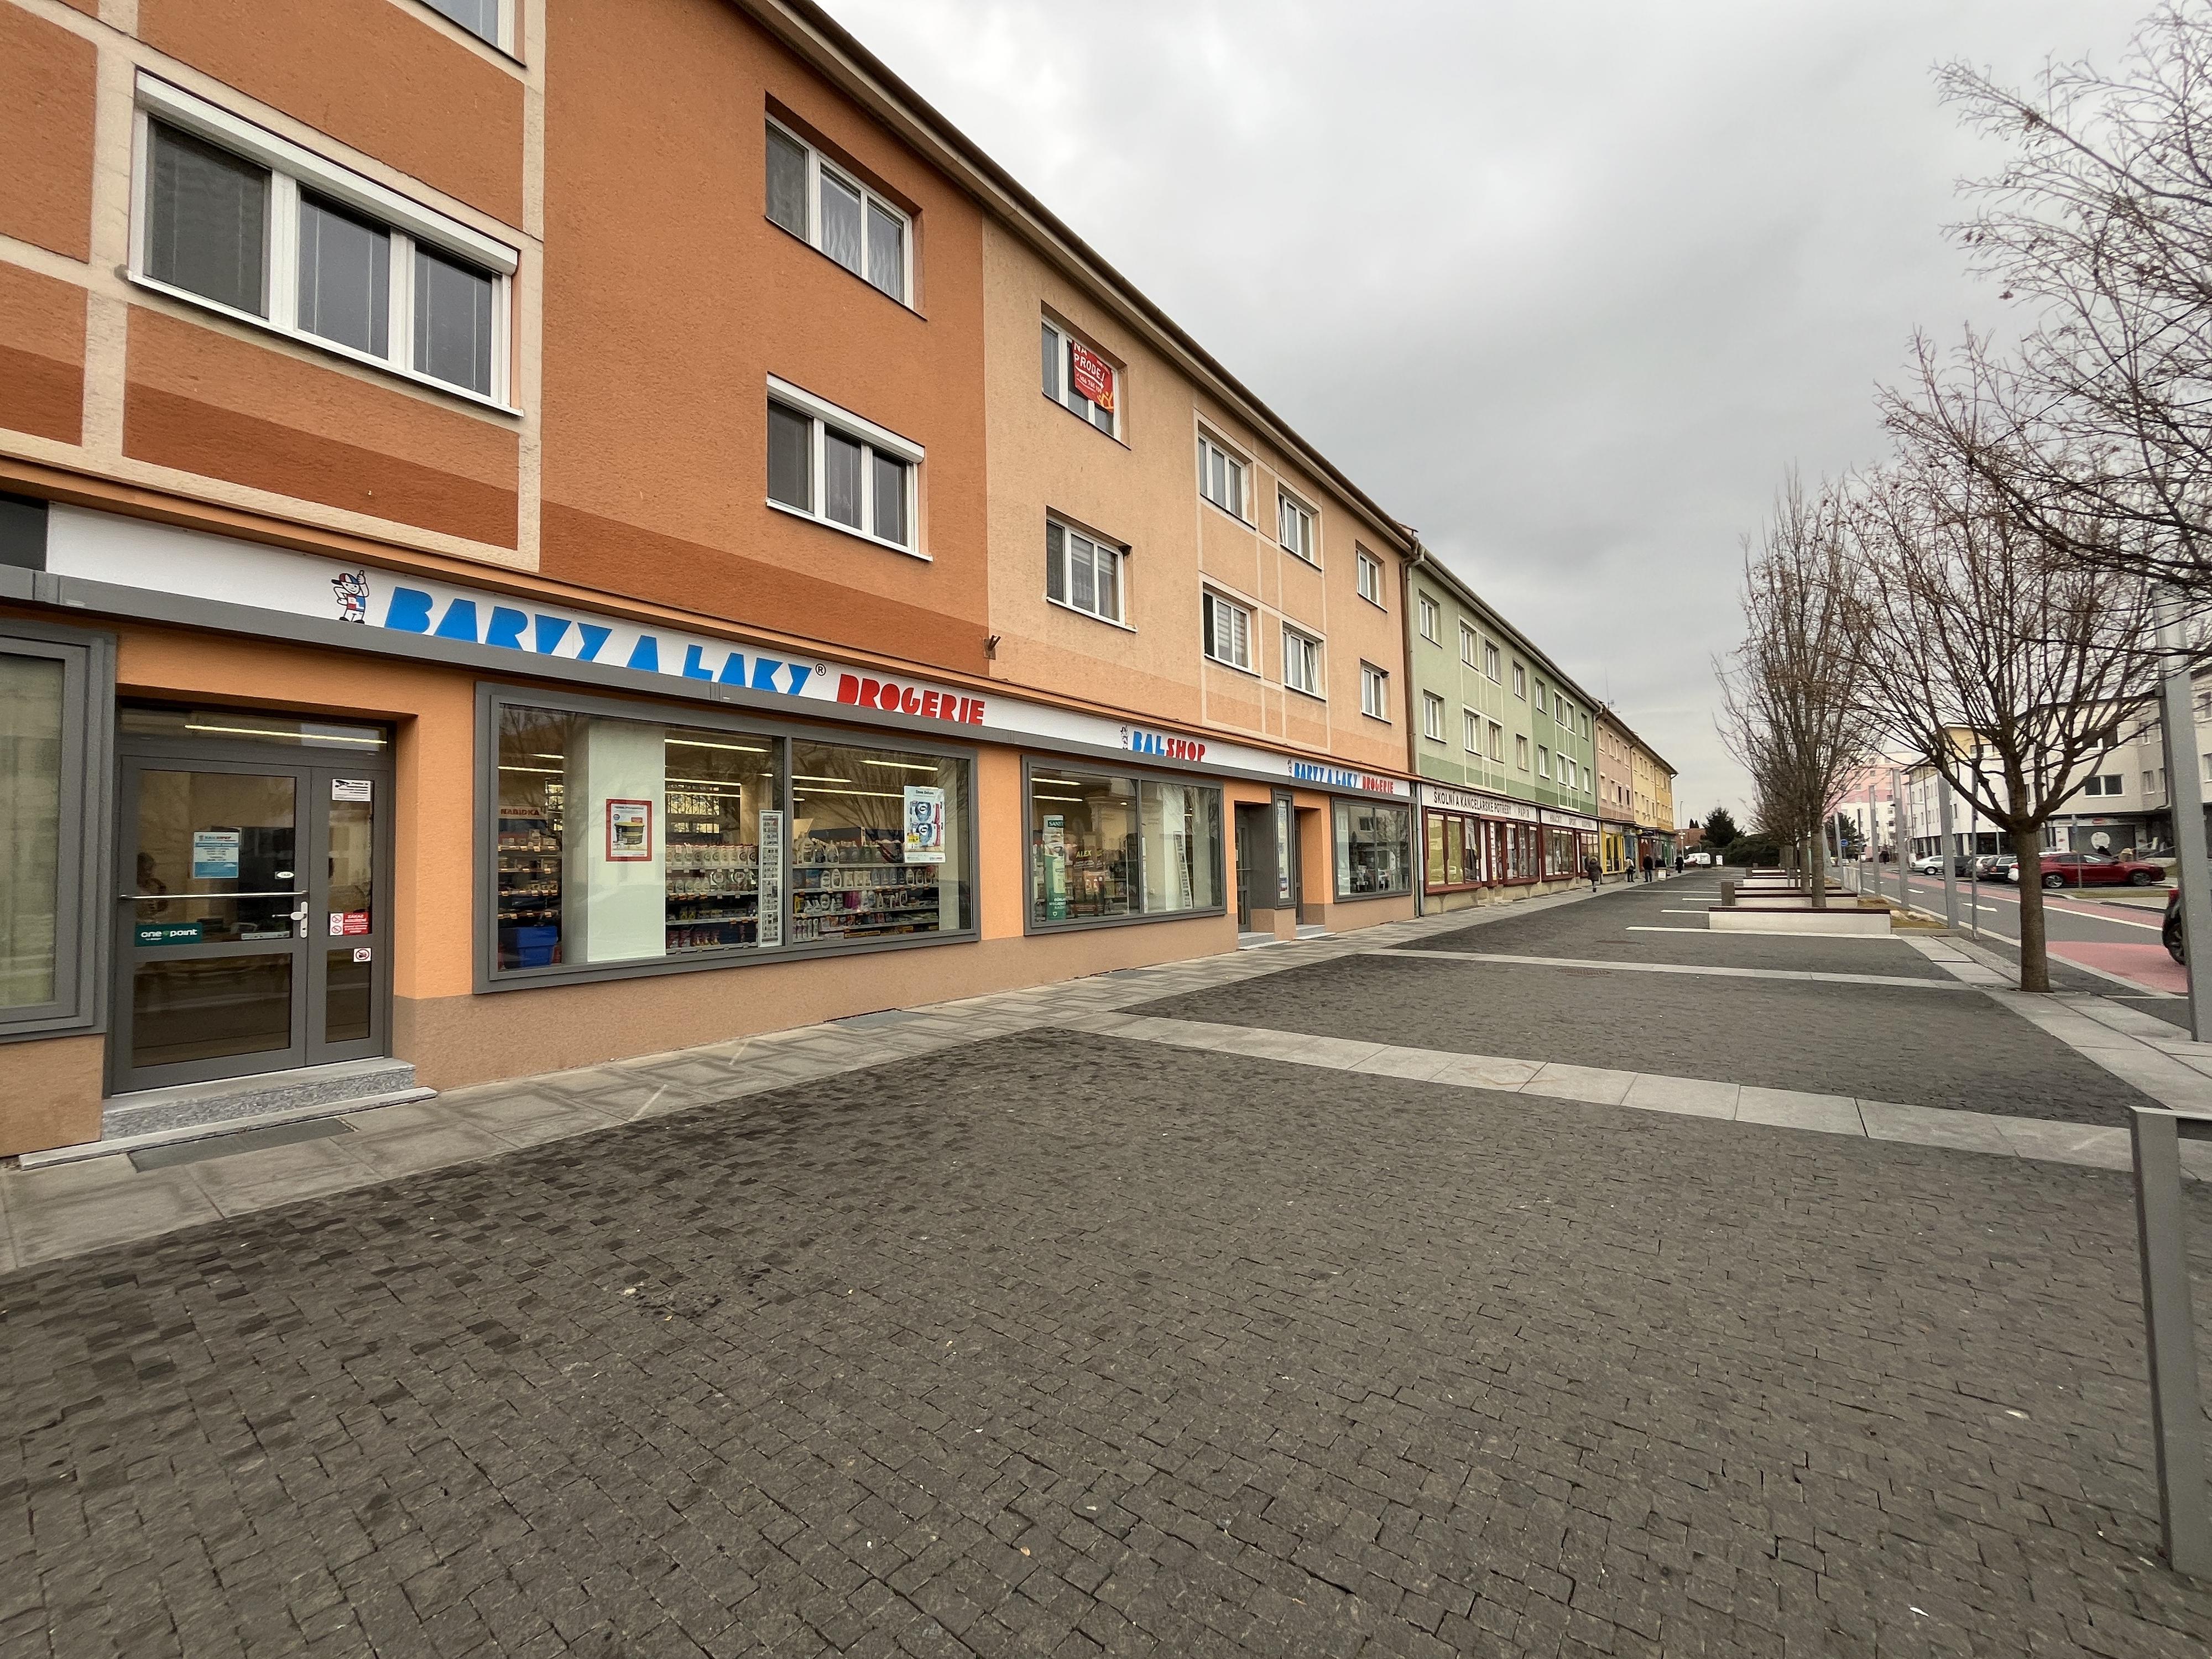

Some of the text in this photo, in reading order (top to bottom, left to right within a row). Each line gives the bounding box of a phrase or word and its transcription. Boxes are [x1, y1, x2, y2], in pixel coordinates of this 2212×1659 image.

[1074, 353, 1105, 382] PRODEJ
[384, 586, 985, 726] BARVY A LAKY DROGERIE
[1133, 731, 1205, 762] BALSHOP
[1295, 763, 1394, 794] BARVY A LAKY DROGERIE
[1434, 788, 1455, 806] ŠKOLNÍ
[1456, 795, 1460, 807] A
[1076, 850, 1092, 858] ALEX
[169, 929, 197, 937] point
